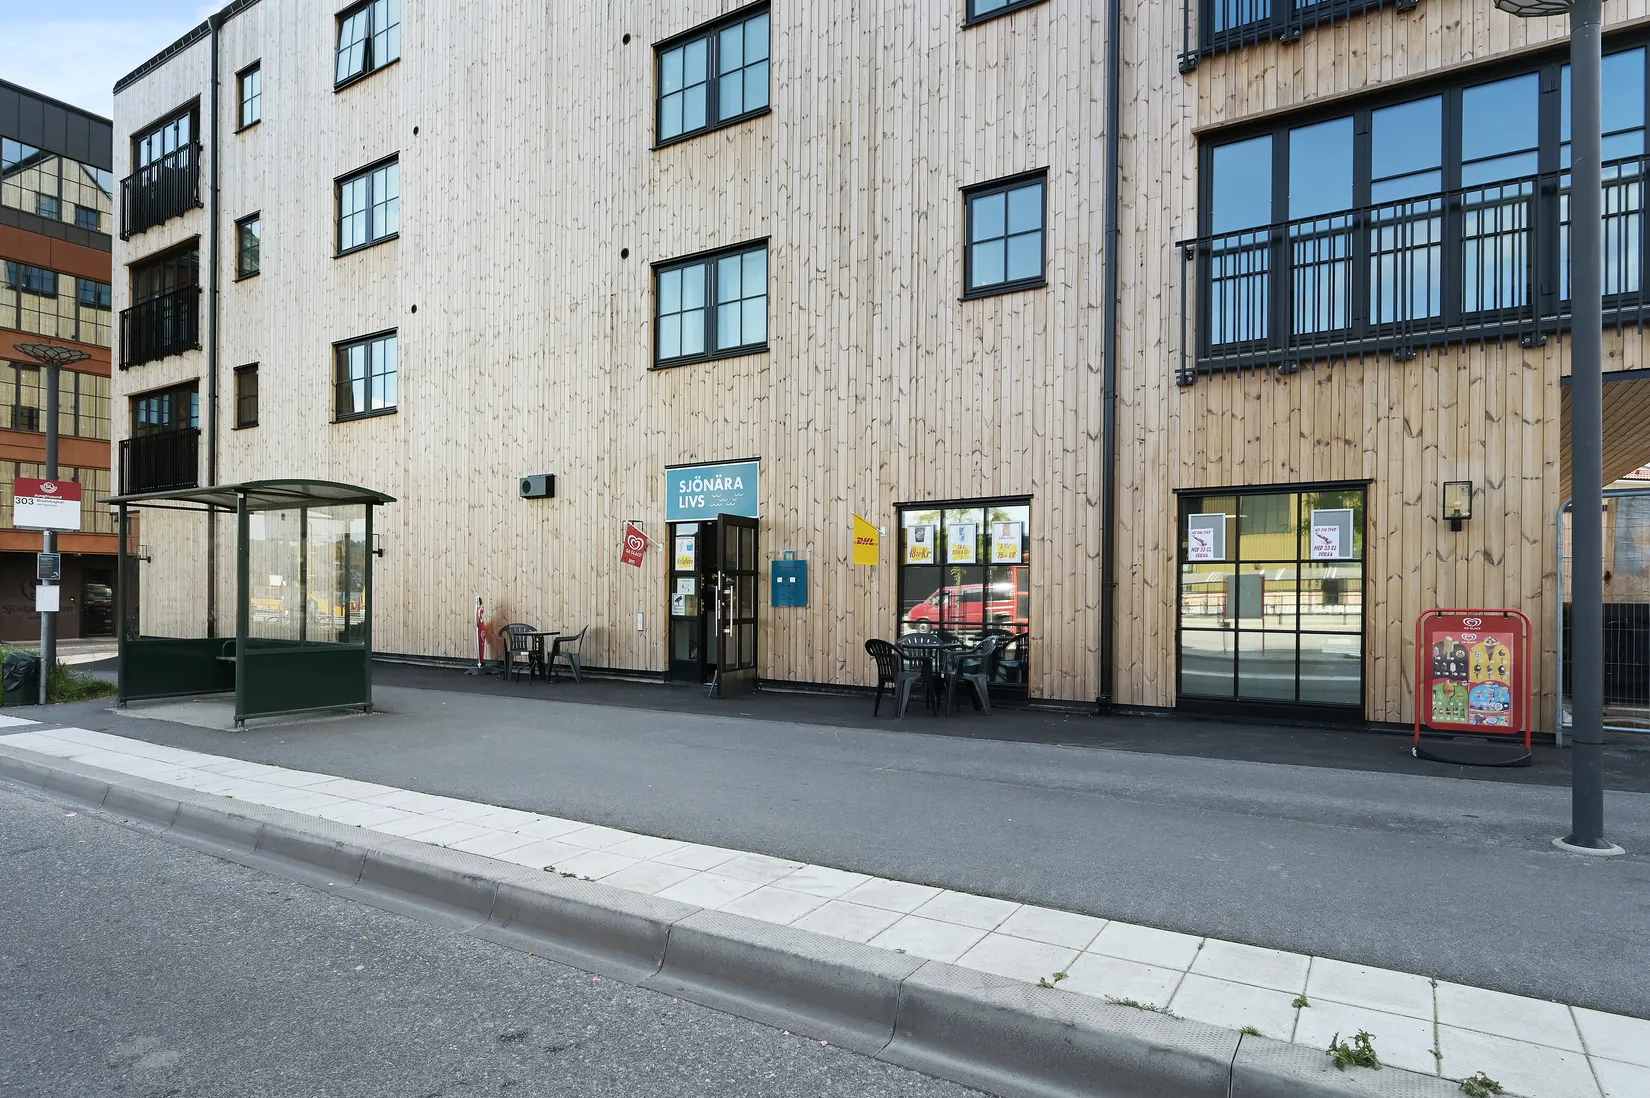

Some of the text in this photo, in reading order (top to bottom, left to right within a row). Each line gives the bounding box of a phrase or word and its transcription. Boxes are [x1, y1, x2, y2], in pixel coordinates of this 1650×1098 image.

[679, 474, 744, 493] SJÖNÄRA
[15, 497, 34, 506] 303
[679, 495, 705, 509] LIVS
[857, 537, 874, 545] DHL
